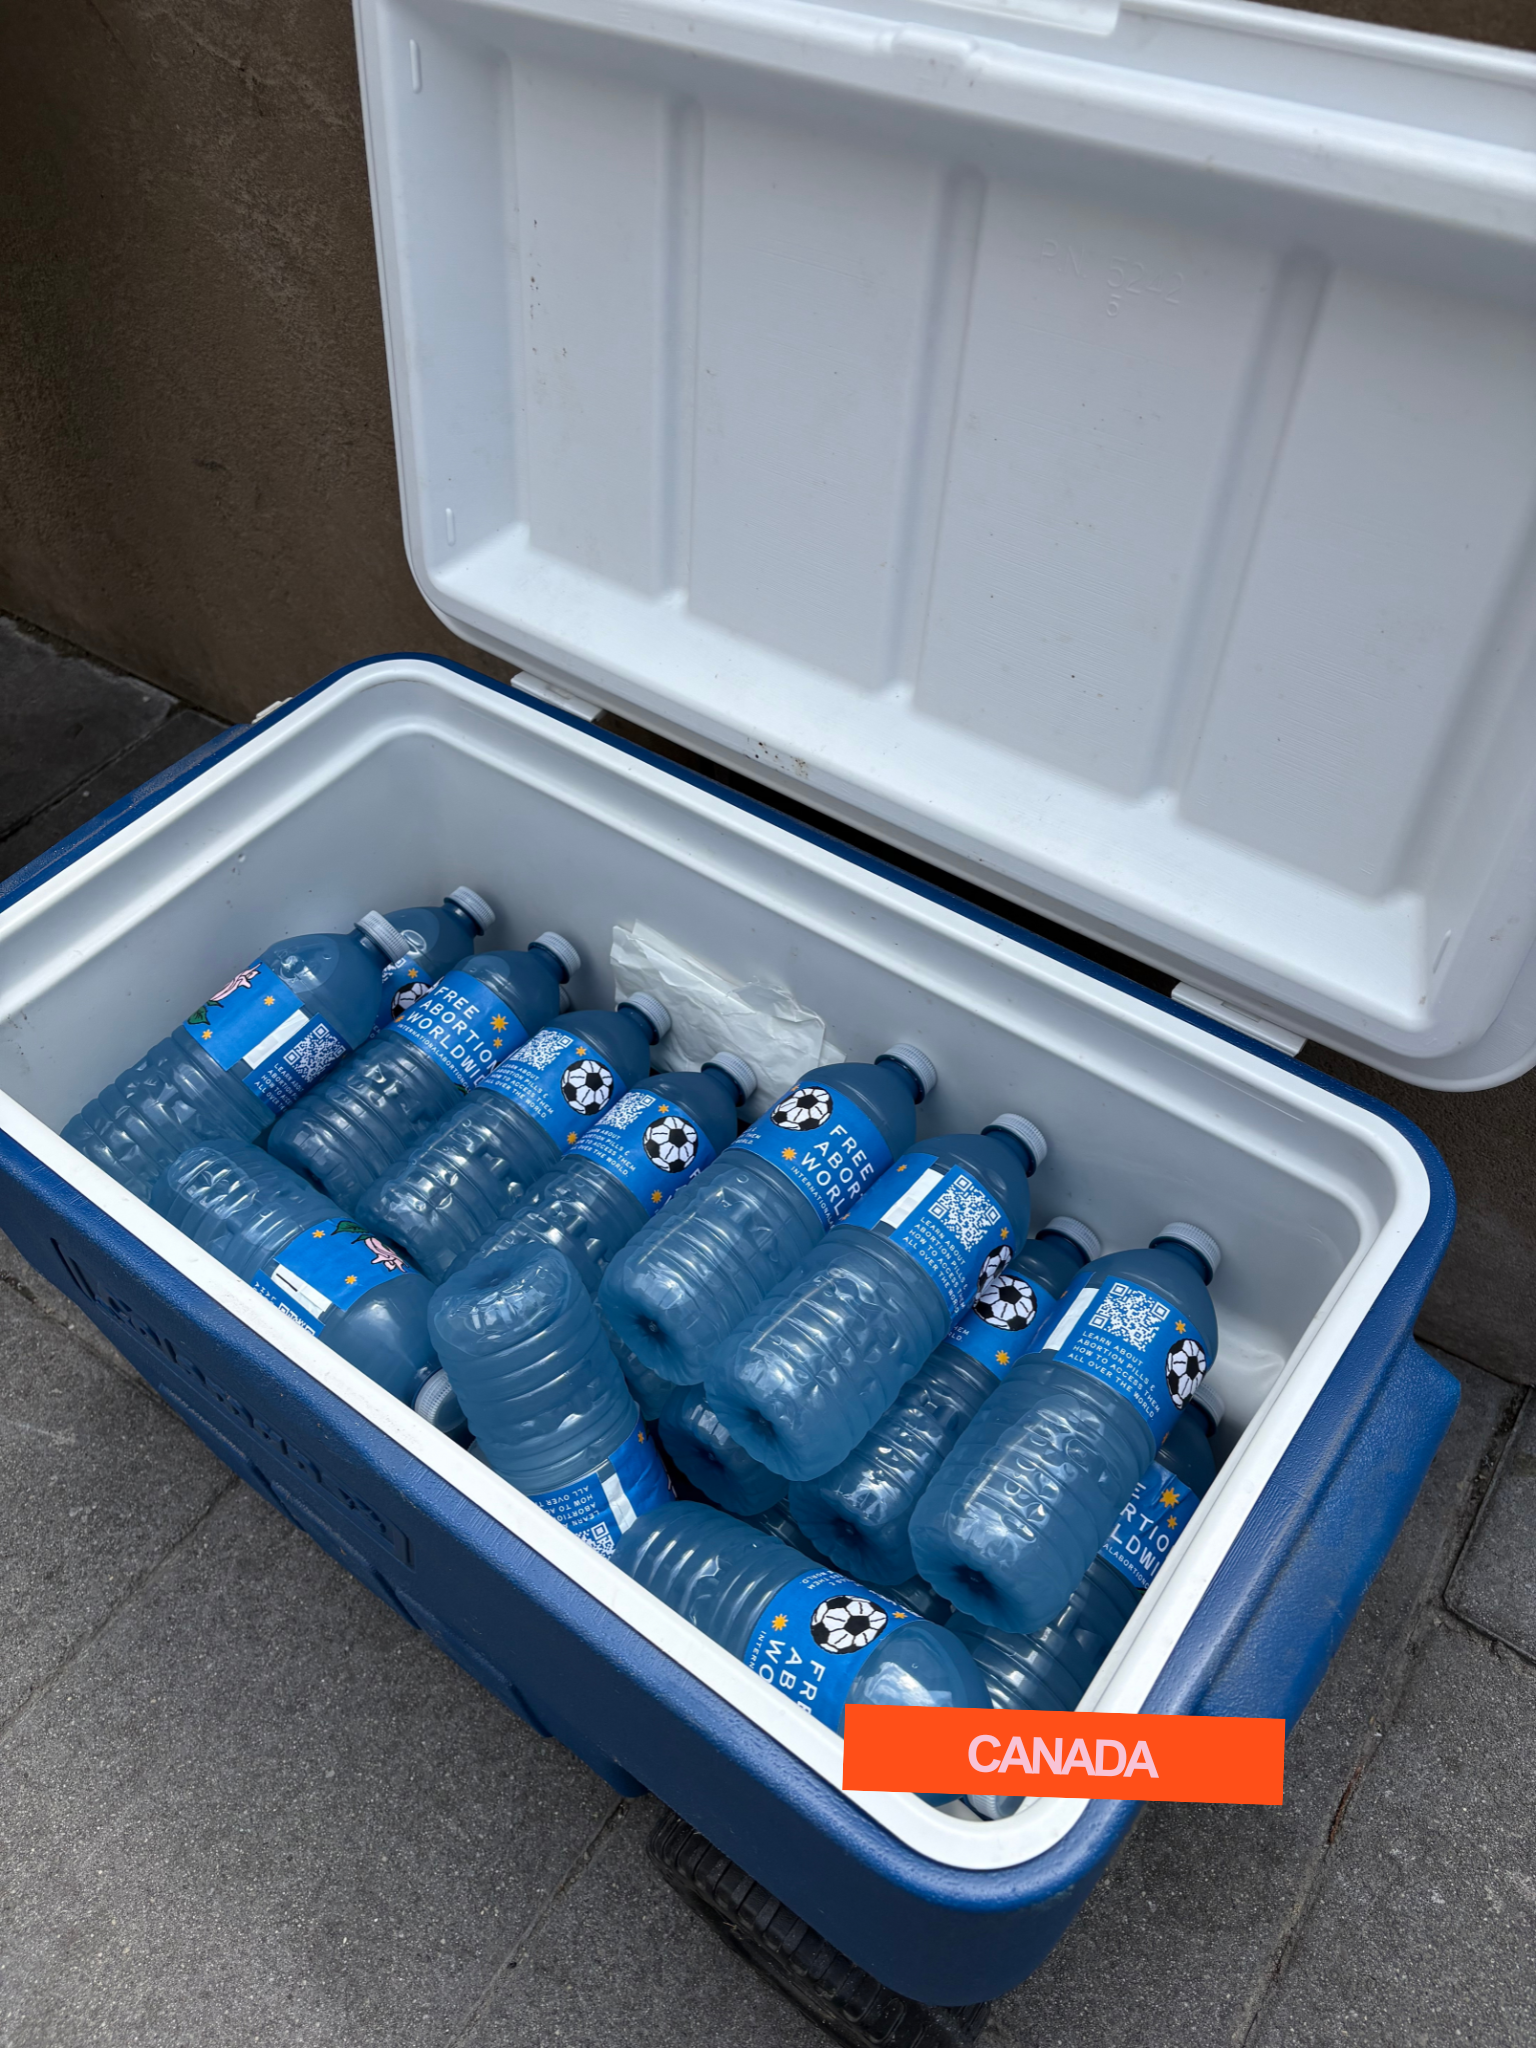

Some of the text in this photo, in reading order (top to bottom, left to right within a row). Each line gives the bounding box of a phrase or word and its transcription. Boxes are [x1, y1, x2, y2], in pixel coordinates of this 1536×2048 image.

[1106, 255, 1185, 306] 5242
[433, 986, 480, 1020] FREE
[254, 1080, 267, 1093] ALL
[494, 1080, 512, 1090] OVER
[512, 1088, 526, 1100] THE
[518, 1067, 540, 1081] ABOUT
[524, 1078, 543, 1094] PILLS
[510, 1080, 536, 1098] ACCESS
[536, 1097, 554, 1114] THEM
[600, 1129, 621, 1140] ABOUT
[605, 1138, 625, 1151] PILLS
[592, 1141, 617, 1156] ACCESS
[617, 1155, 637, 1171] THEM
[593, 1149, 606, 1158] THE
[829, 1124, 875, 1181] FREE
[813, 1141, 863, 1200] ABOR
[914, 1223, 952, 1260] ABORTION
[951, 1260, 966, 1283] PILLS
[920, 1216, 966, 1265] LEARN ABOUT
[902, 1236, 918, 1250] ALL
[919, 1249, 939, 1271] OVER
[938, 1270, 951, 1288] THE
[908, 1229, 927, 1245] HOW
[927, 1244, 938, 1257] TO
[937, 1258, 960, 1288] ACCESS
[1077, 1338, 1124, 1364] ABORTION
[1126, 1363, 1149, 1385] PILLS
[1082, 1330, 1143, 1366] LEARN ABOUT
[1067, 1352, 1084, 1363] ALL
[1087, 1361, 1113, 1378] OVER
[1115, 1376, 1133, 1393] THE
[1072, 1345, 1161, 1413] HOW TO ACCESS THEM
[546, 1494, 570, 1506] OVER
[572, 1485, 589, 1496] ALL
[573, 1494, 593, 1507] HOW
[558, 1504, 572, 1512] TO
[571, 1509, 600, 1526] LEARN
